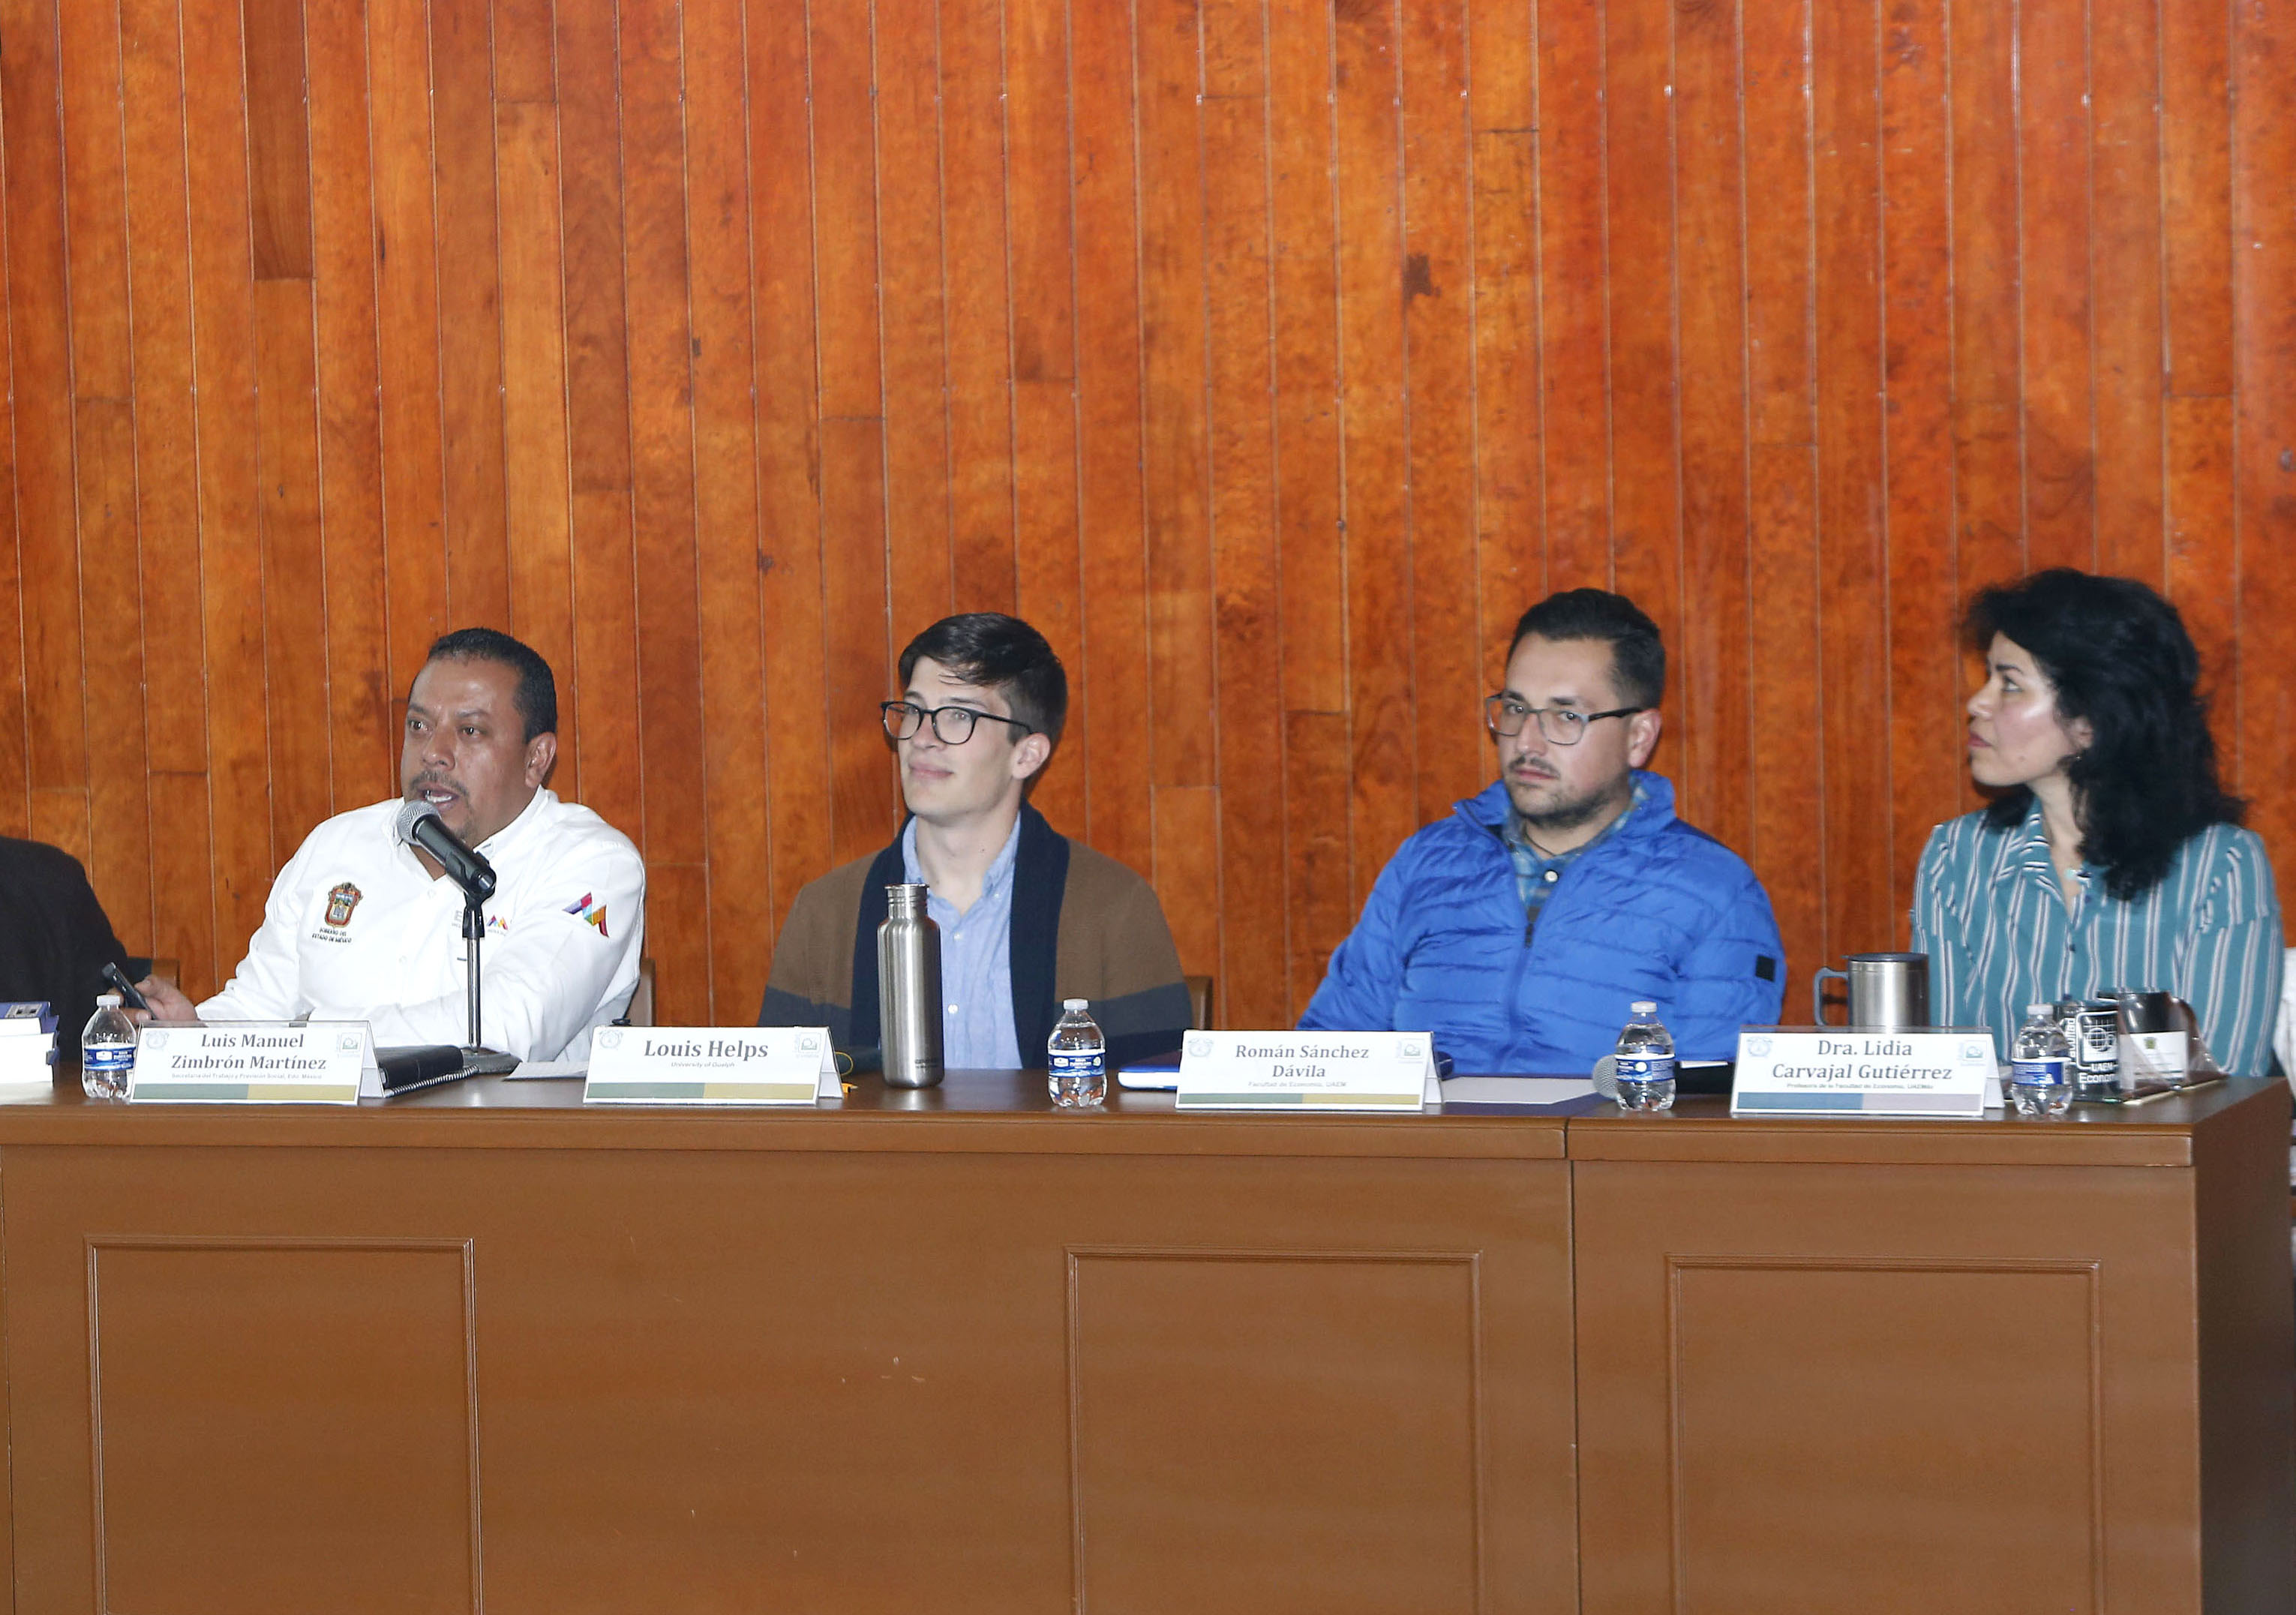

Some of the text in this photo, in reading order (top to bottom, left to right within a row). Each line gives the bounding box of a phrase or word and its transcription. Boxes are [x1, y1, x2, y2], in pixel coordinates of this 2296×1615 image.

[201, 1033, 304, 1048] Luis Manuel
[1817, 1040, 1913, 1056] Dra. Lidia
[644, 1040, 769, 1061] Louis Helps
[1235, 1044, 1369, 1058] Román Sánchez
[171, 1054, 327, 1070] Zimbrón Martínez
[1272, 1064, 1326, 1078] Dávila
[1772, 1063, 1953, 1082] Carvajal Gutiérrez
